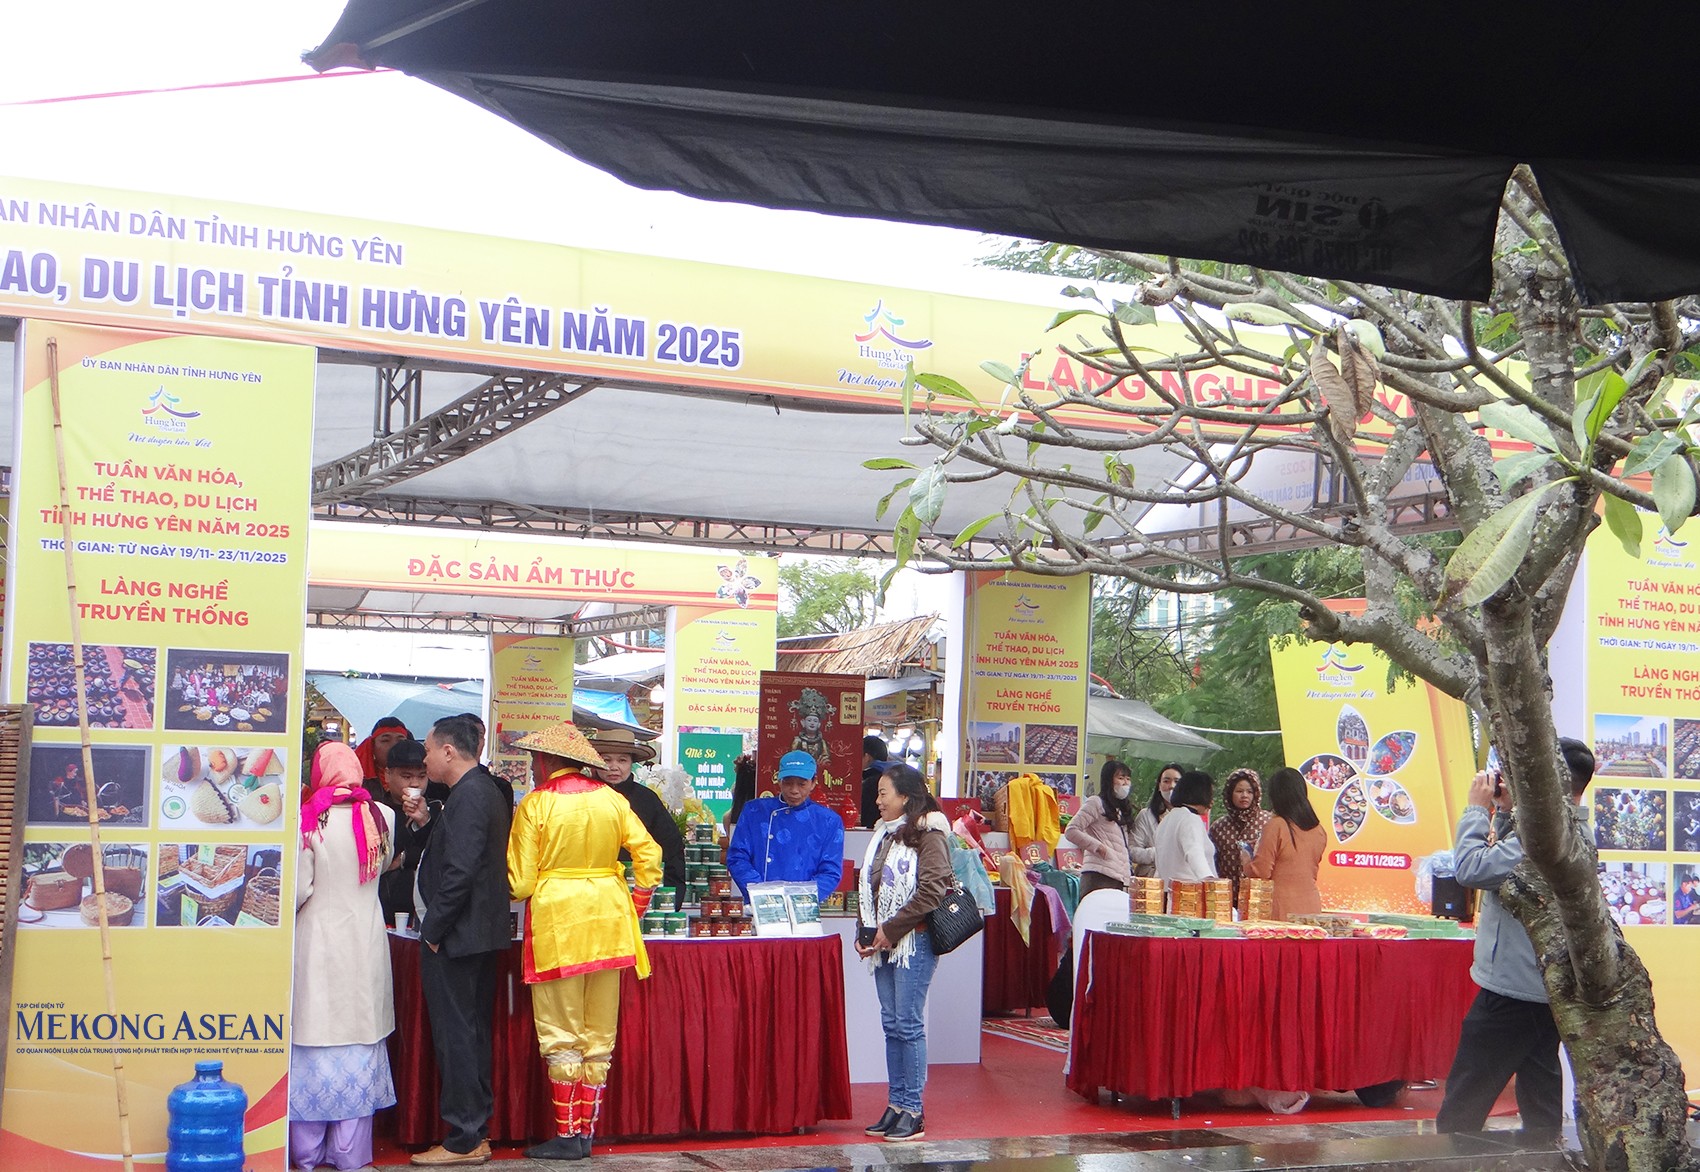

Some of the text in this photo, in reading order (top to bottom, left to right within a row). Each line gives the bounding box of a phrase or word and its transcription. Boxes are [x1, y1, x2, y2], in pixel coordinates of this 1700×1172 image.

[39, 203, 402, 266] NHÂN DÂN TỈNH HƯNG YÊN
[84, 258, 139, 302] DU
[154, 265, 243, 317] LỊCH
[258, 265, 348, 324] TỈNH
[362, 289, 466, 337] HƯNG
[479, 297, 549, 346] YÊN
[563, 307, 645, 357] NĂM
[657, 324, 740, 367] 2025
[82, 356, 262, 383] ỦY BAN NHÂN DÂN TỈNH HƯNG YÊN
[94, 459, 243, 489] TUẦN VĂN HÓA,
[77, 481, 258, 514] THỂ THAO, DU LỊCH
[92, 513, 149, 530] HƯNG
[154, 514, 192, 533] YÊN
[198, 517, 240, 535] NĂM
[246, 523, 290, 538] 2025
[78, 542, 115, 554] GIAN:
[118, 542, 139, 555] TỪ
[142, 545, 177, 558] NGÀY
[180, 548, 215, 560] 19/11-
[218, 549, 287, 564] 23/11/2025
[408, 555, 635, 592] ĐẶC SẢN ẨM THỰC
[101, 576, 229, 601] LÀNG NGHỀ
[1627, 578, 1659, 593] TUẦN
[1661, 581, 1684, 595] VĂN
[77, 600, 249, 627] TRUYỀN THỐNG
[1618, 596, 1695, 615] THỂ THAO, DU
[1598, 612, 1685, 632] TỈNH HƯNG YÊN
[994, 629, 1058, 644] TUẦN VĂN HÓA,
[1620, 639, 1641, 648] GIAN:
[1004, 645, 1031, 655] THAO,
[1032, 647, 1044, 655] DU
[1046, 648, 1064, 656] LỊCH
[975, 654, 991, 664] ỈNH
[993, 657, 1018, 666] HƯNG
[1020, 658, 1036, 666] YÊN
[1058, 660, 1079, 668] 2025
[1634, 664, 1669, 680] LÀNG
[996, 688, 1023, 699] LÀNG
[1621, 683, 1672, 699] TRUYỀN
[688, 704, 705, 713] ĐẶC
[1027, 701, 1061, 713] THỐNG
[1335, 853, 1347, 864] 19
[1354, 854, 1405, 867] 23/11/2025
